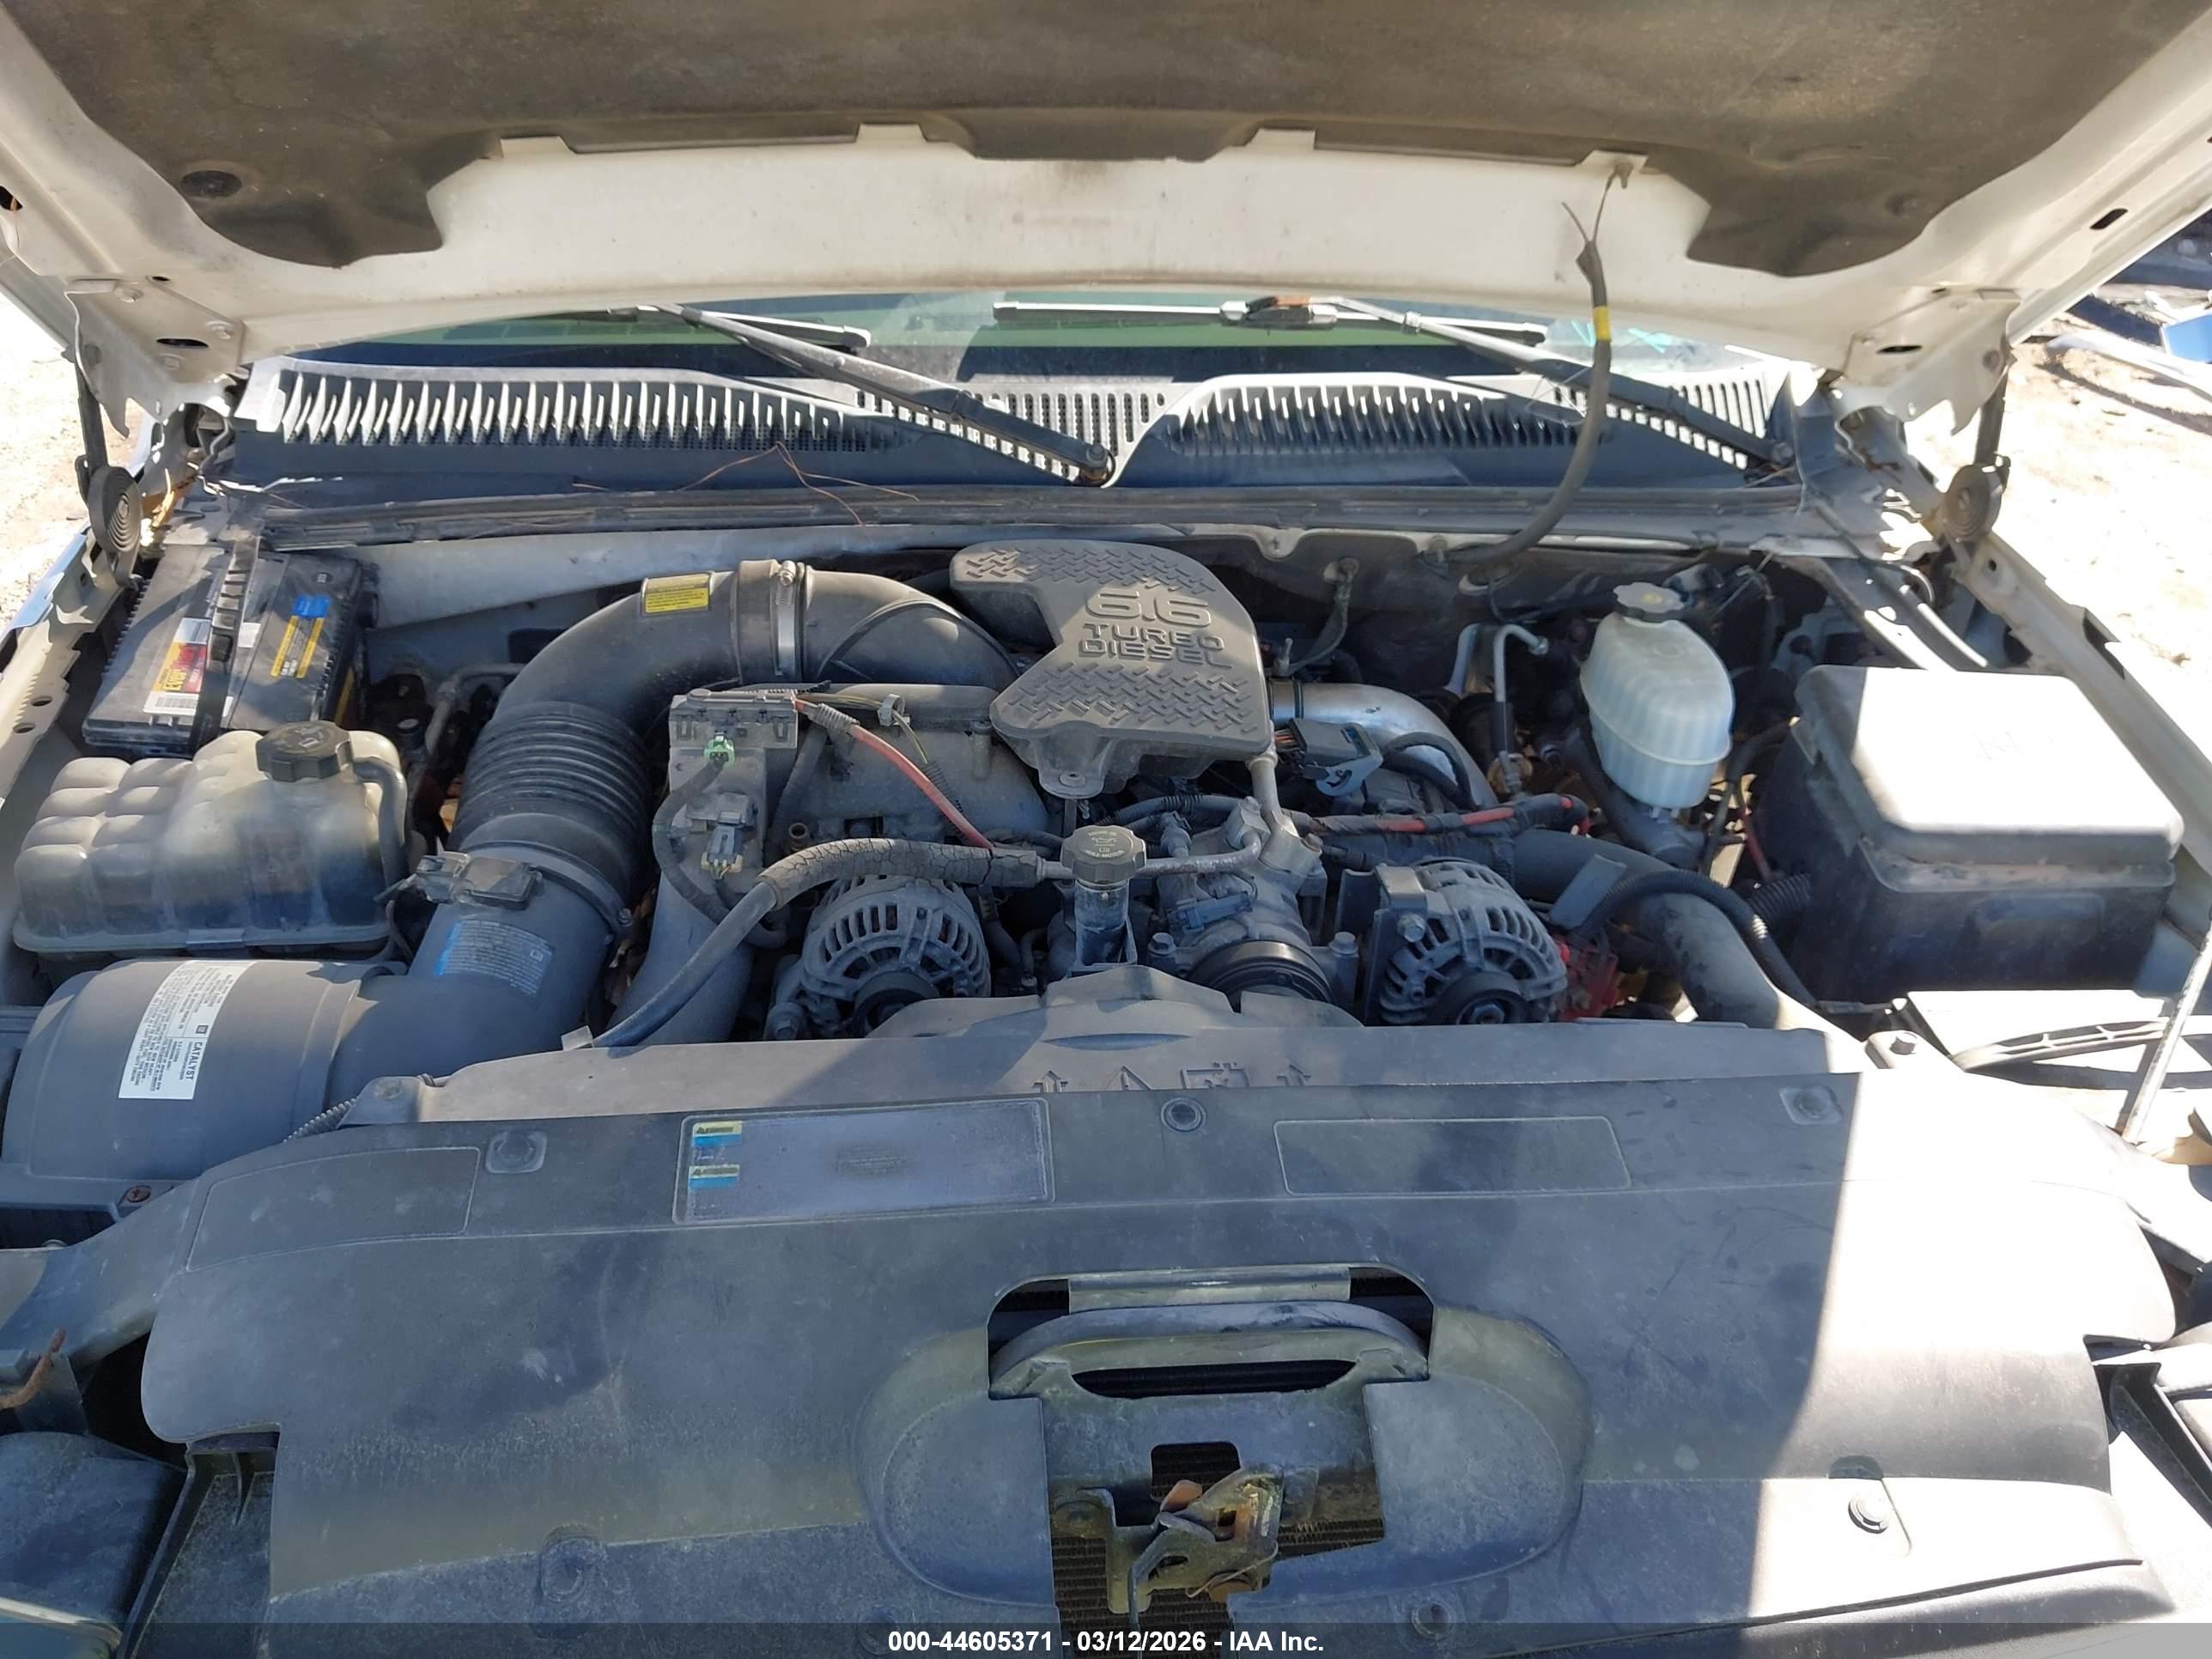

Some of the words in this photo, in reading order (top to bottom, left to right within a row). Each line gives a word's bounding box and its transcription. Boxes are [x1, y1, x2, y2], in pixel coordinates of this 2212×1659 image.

[1085, 590, 1212, 628] 6.6
[1079, 638, 1232, 669] DIESEL
[1083, 623, 1224, 652] TURBO
[185, 1042, 204, 1080] CATALYST
